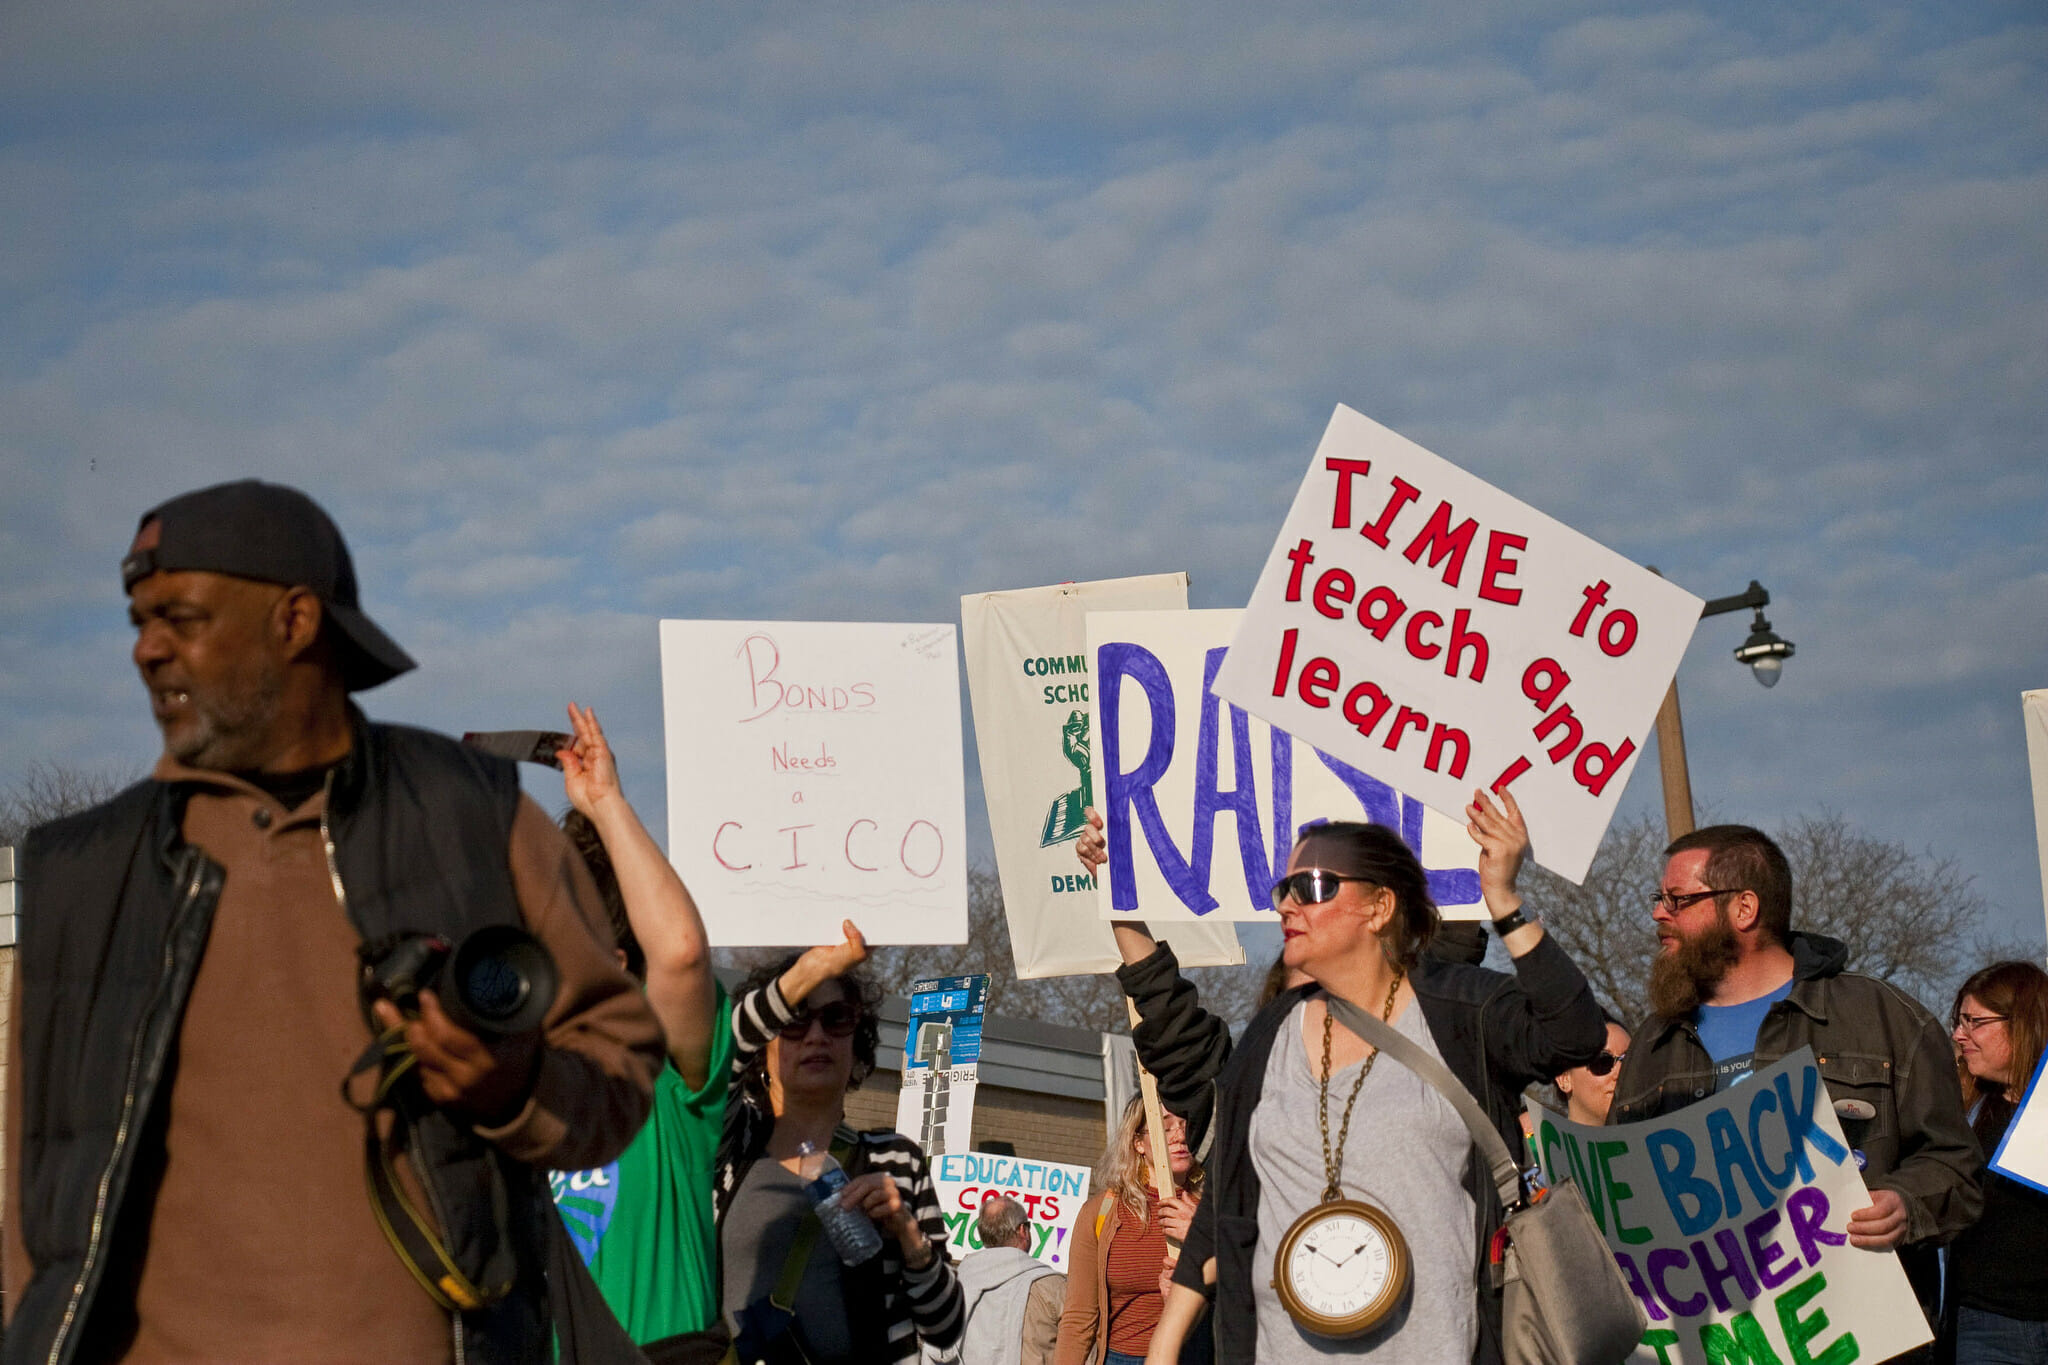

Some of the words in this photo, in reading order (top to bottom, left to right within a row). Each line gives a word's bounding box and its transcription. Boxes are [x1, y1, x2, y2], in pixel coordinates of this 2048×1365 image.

[1326, 457, 1528, 606] TIME
[1569, 579, 1638, 657] to
[1272, 628, 1471, 780] learn
[1285, 539, 1489, 683] teach
[1521, 657, 1636, 797] and
[772, 742, 836, 771] Needs
[792, 791, 804, 804] a
[940, 1154, 1085, 1197] EDUCATION
[1645, 1066, 1849, 1236] BACK
[958, 1186, 1060, 1221] CTS
